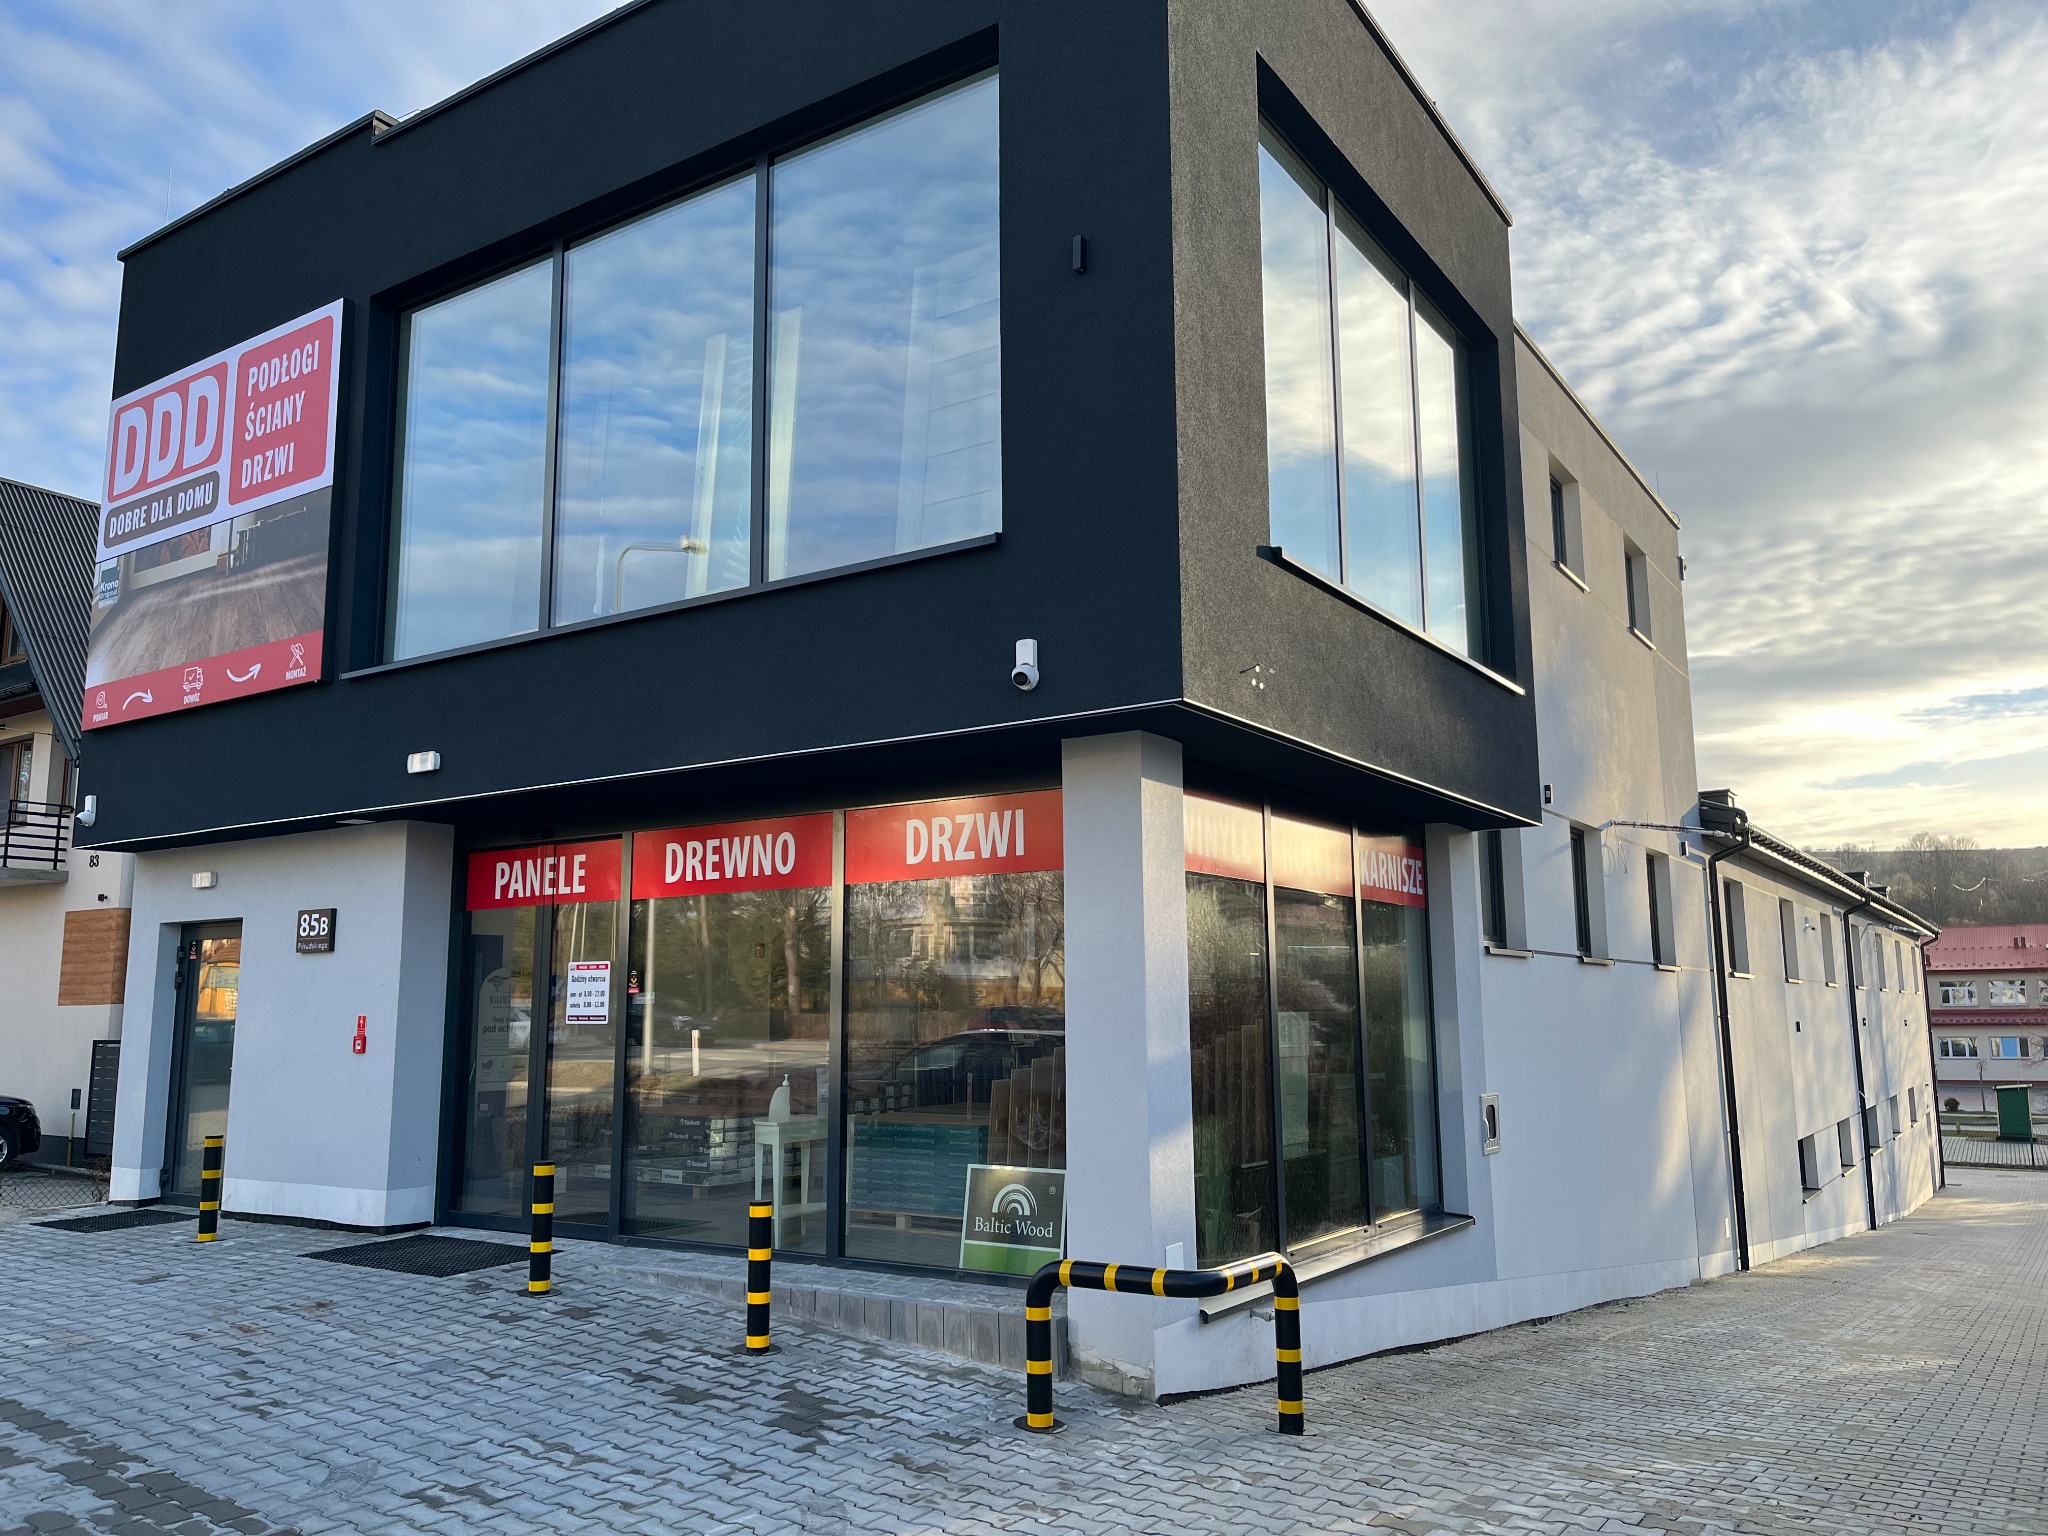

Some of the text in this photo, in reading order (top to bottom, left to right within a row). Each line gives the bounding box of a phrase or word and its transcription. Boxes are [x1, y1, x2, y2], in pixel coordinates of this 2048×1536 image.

[247, 339, 320, 397] PODŁOGI
[113, 375, 219, 496] DDD
[244, 391, 305, 441] ŚCIANY
[241, 442, 295, 488] DRZWI
[109, 481, 213, 538] DOBRE DLA DOMU
[100, 580, 118, 592] Krono
[664, 831, 796, 884] DREWNO
[906, 808, 1025, 865] DRZWI
[89, 855, 100, 868] 83
[494, 854, 586, 899] PANELE
[1360, 848, 1424, 896] KARNISZE
[299, 913, 329, 937] 85B
[974, 1216, 1054, 1238] Baltic Wood
